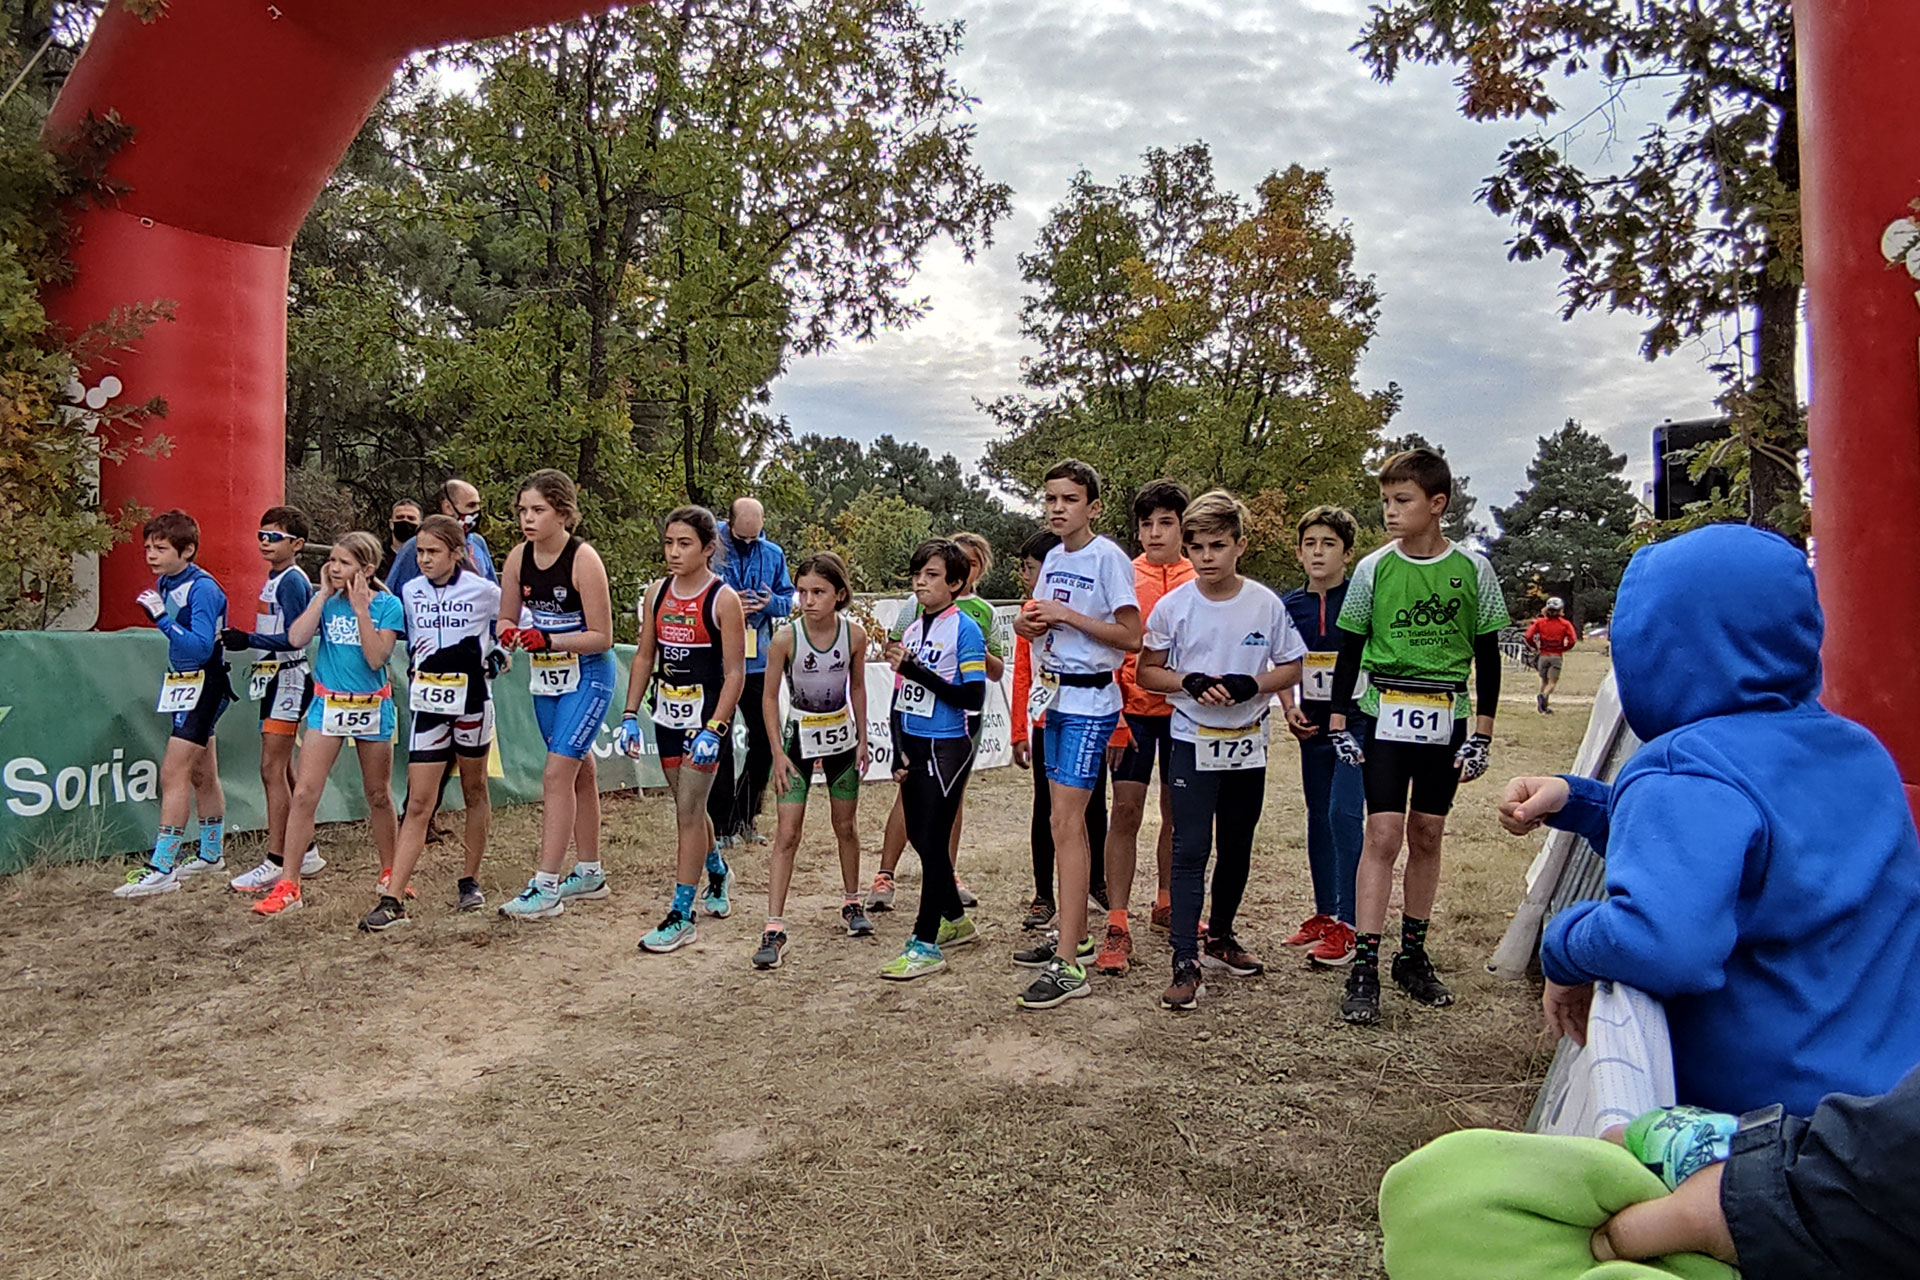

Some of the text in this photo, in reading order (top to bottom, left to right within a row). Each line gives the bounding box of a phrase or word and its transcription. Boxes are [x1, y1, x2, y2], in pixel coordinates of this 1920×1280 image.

[413, 600, 473, 613] Triatlón
[1409, 637, 1449, 647] SEGOVIA
[663, 646, 690, 662] ESP
[540, 669, 570, 686] 157
[169, 687, 196, 703] 172
[420, 687, 456, 704] 158
[662, 701, 693, 719] 159
[334, 711, 371, 727] 155
[1392, 708, 1439, 731] 161
[811, 725, 849, 746] 153
[1208, 739, 1253, 758] 173
[3, 748, 158, 817] Soria
